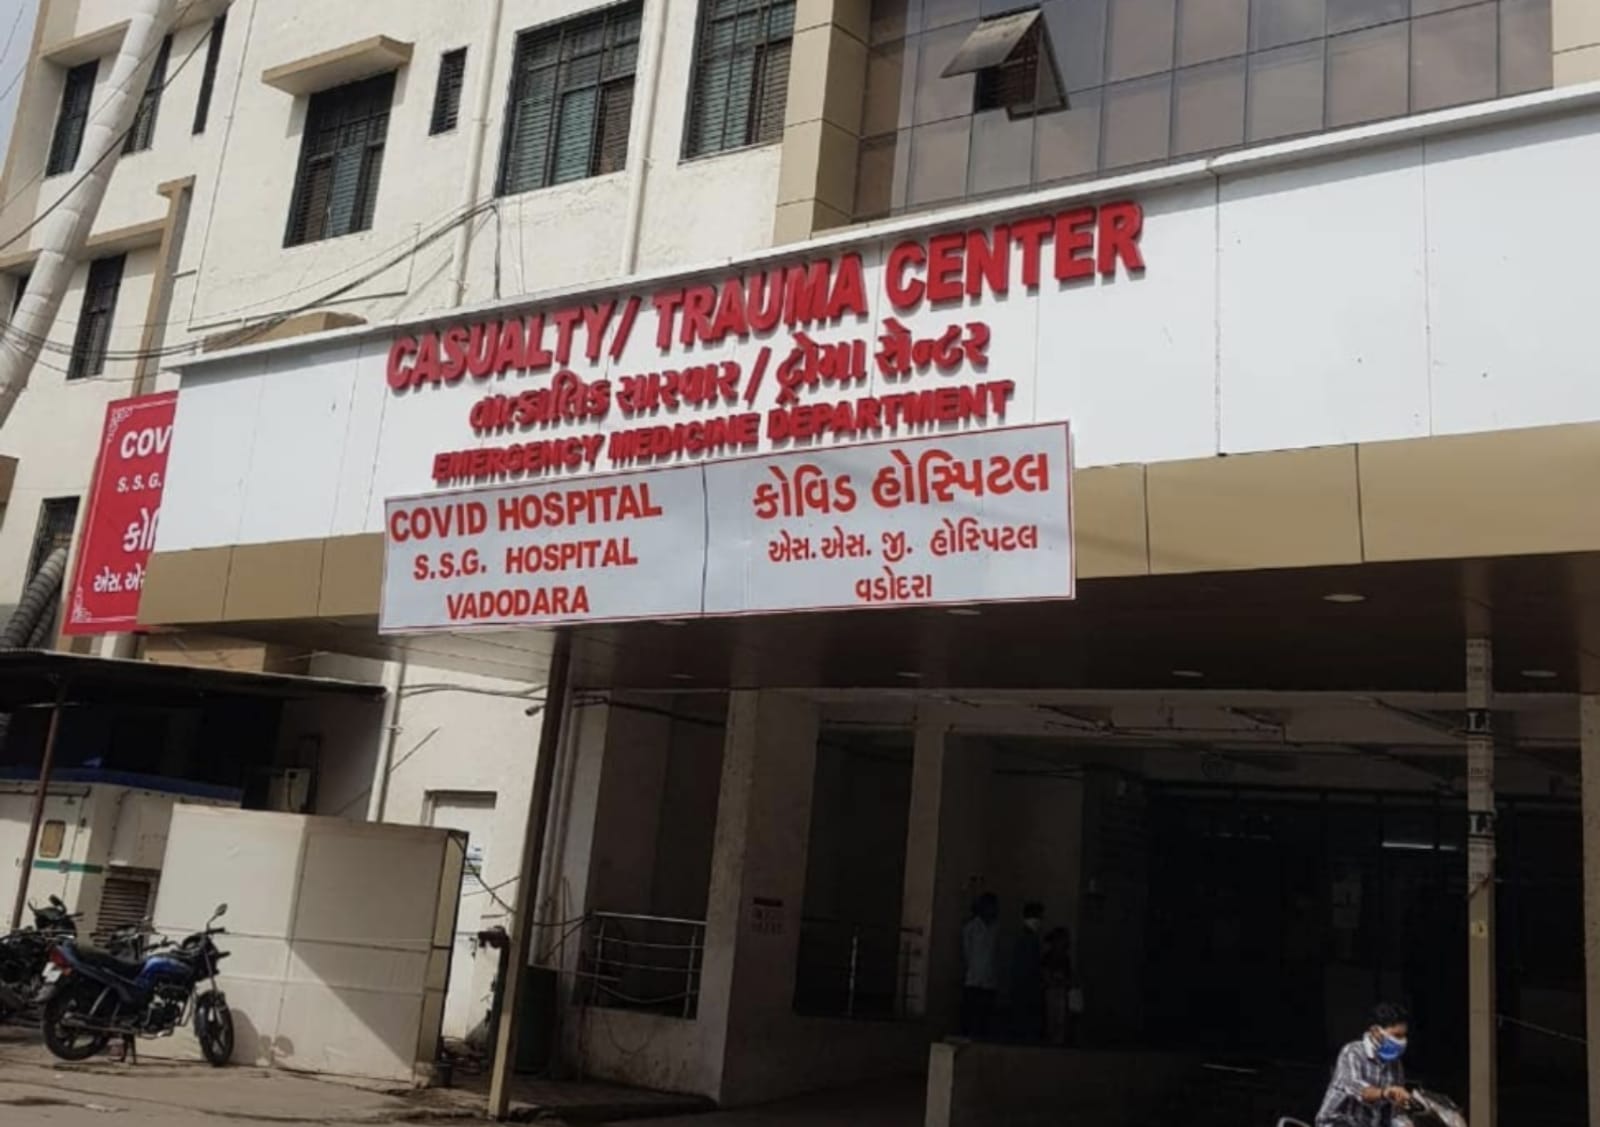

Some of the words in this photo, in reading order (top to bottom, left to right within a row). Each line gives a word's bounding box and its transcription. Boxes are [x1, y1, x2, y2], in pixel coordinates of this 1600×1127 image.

[654, 253, 868, 350] TRAUMA
[885, 200, 1146, 311] CENTER
[432, 434, 604, 483] EMERGENCY
[607, 412, 761, 461] MEDICINE
[766, 379, 1015, 441] DEPARTMENT
[390, 502, 488, 543] COVID
[497, 482, 664, 532] HOSPITAL
[752, 463, 857, 521] કોવિડ
[871, 448, 1050, 508] હોસ્પિટલ
[505, 537, 638, 575] HOSPITAL
[855, 565, 932, 602] વડોદરા
[446, 585, 590, 620] VADODARA
